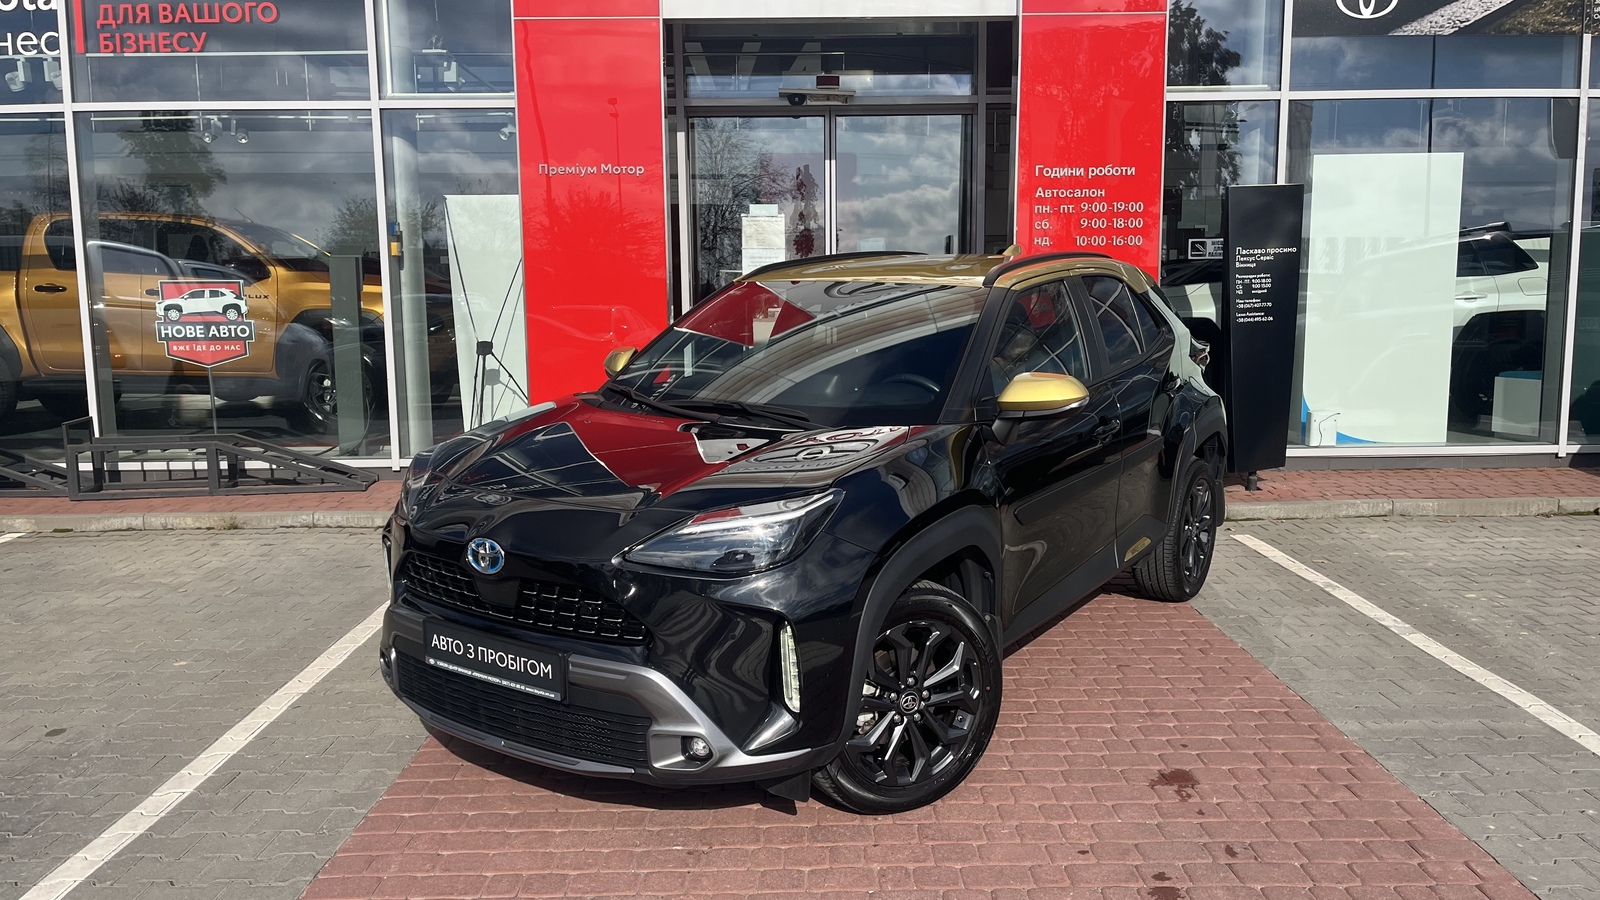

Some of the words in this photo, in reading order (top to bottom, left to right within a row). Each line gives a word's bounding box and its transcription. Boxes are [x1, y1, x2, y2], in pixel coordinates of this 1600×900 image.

[97, 3, 150, 29] ДЛЯ
[158, 1, 279, 24] ВАШОГО
[99, 31, 207, 53] БІЗНЕСУ
[538, 163, 597, 177] Преміум
[600, 163, 645, 177] Мотор
[1035, 165, 1084, 179] Години
[1088, 164, 1136, 179] роботи
[1035, 187, 1105, 198] Автосалон
[1080, 201, 1144, 213] 9:00-19:00
[1034, 219, 1052, 229] сб.
[1080, 217, 1144, 229] 9:00-18:00
[1034, 236, 1053, 247] нд.
[1075, 235, 1143, 247] 10:00-16:00
[1236, 246, 1265, 255] Ласкаво
[1266, 247, 1297, 255] просимо
[161, 325, 205, 338] НОВЕ
[208, 325, 250, 338] АВТО
[431, 633, 464, 656] АВТО
[478, 646, 553, 680] ПРОБІГОМ
